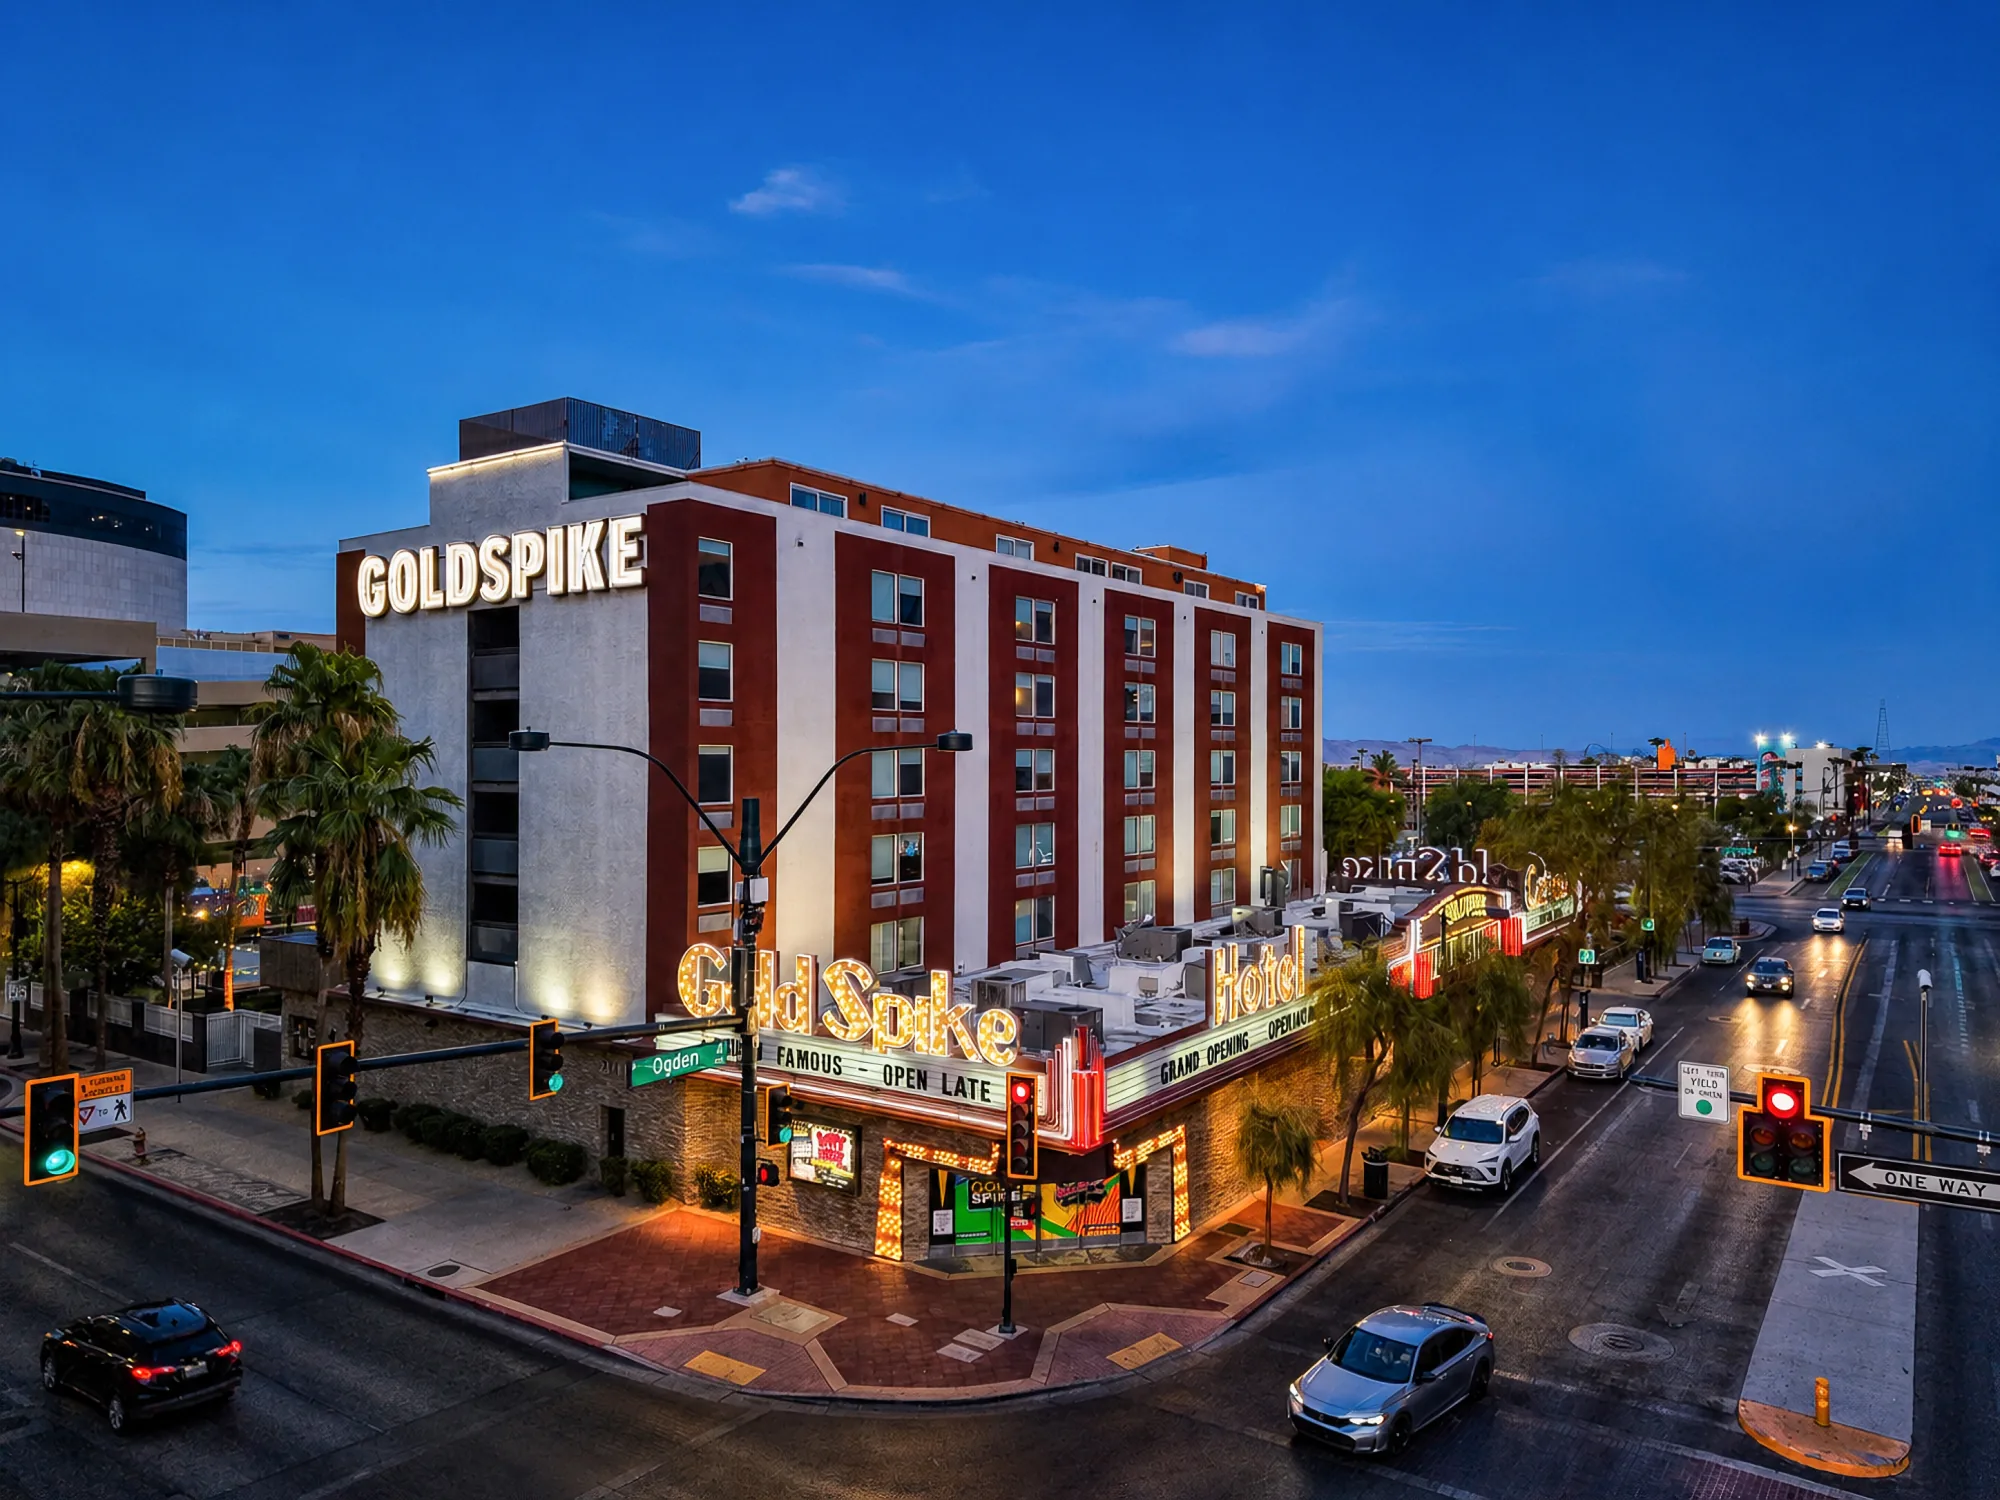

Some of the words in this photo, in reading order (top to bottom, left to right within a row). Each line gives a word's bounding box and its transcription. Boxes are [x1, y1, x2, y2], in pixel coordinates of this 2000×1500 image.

[357, 513, 646, 618] GOLDSPIKE
[1213, 924, 1305, 1026] Hotel
[678, 942, 814, 1036] Gld
[821, 957, 1019, 1067] Spike
[653, 1052, 699, 1077] Ogden
[776, 1045, 843, 1076] FAMOUS
[883, 1064, 928, 1091] OPEN
[942, 1072, 991, 1103] LATE
[1161, 1050, 1200, 1085] GRAND
[1207, 1031, 1249, 1066] OPENING
[1691, 1077, 1718, 1089] YIELD
[98, 1108, 109, 1117] TO
[1885, 1172, 1927, 1190] ONE
[1939, 1176, 1988, 1198] WAY
